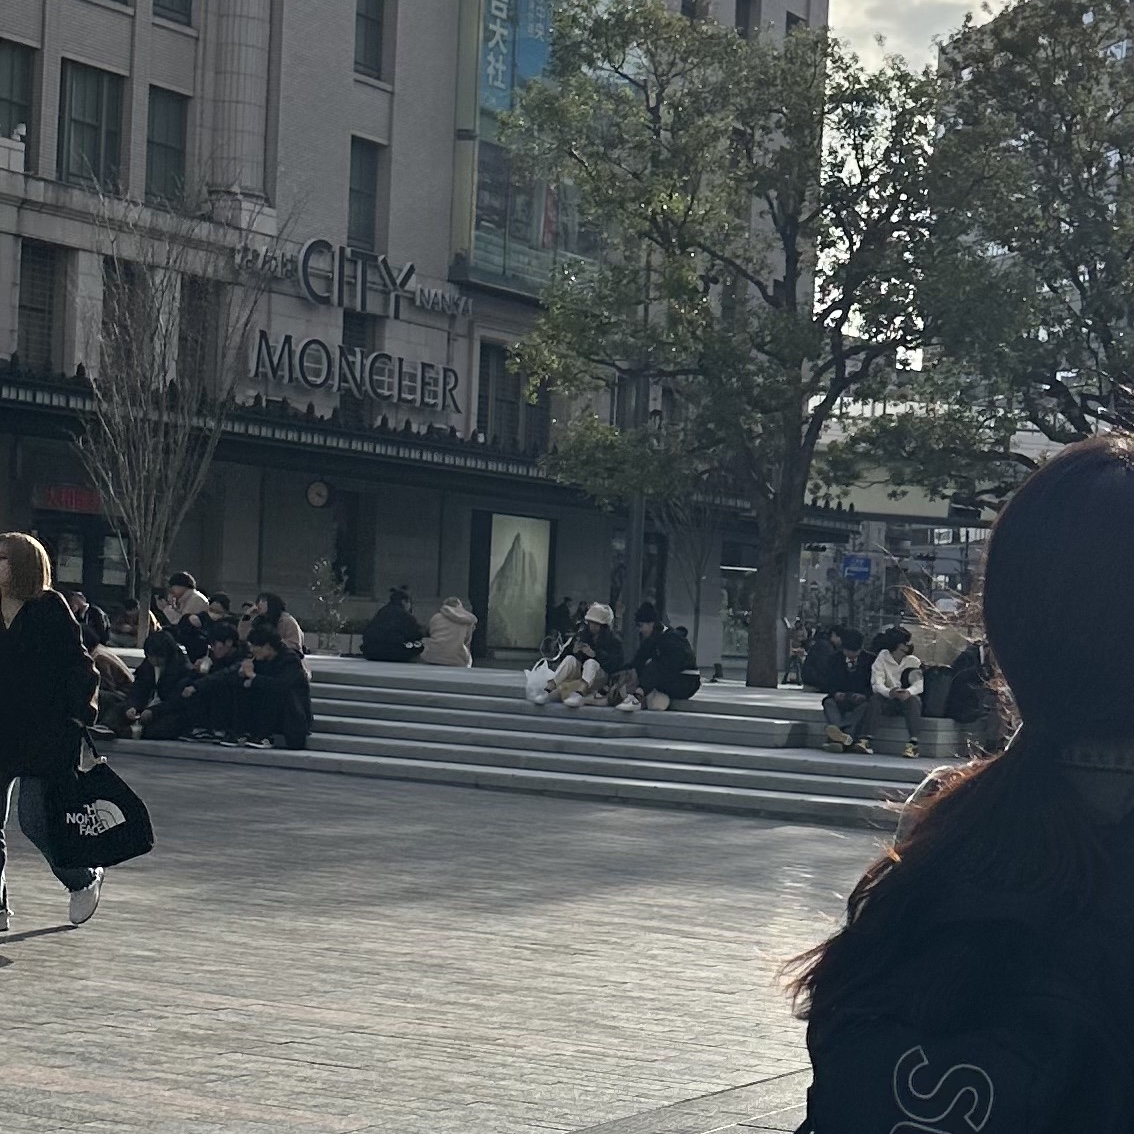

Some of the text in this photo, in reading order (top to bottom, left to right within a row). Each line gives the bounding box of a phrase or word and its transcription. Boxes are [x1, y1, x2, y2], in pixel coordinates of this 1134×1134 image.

[300, 238, 416, 320] CITY
[252, 328, 462, 415] MONCLER
[82, 803, 97, 815] TH
